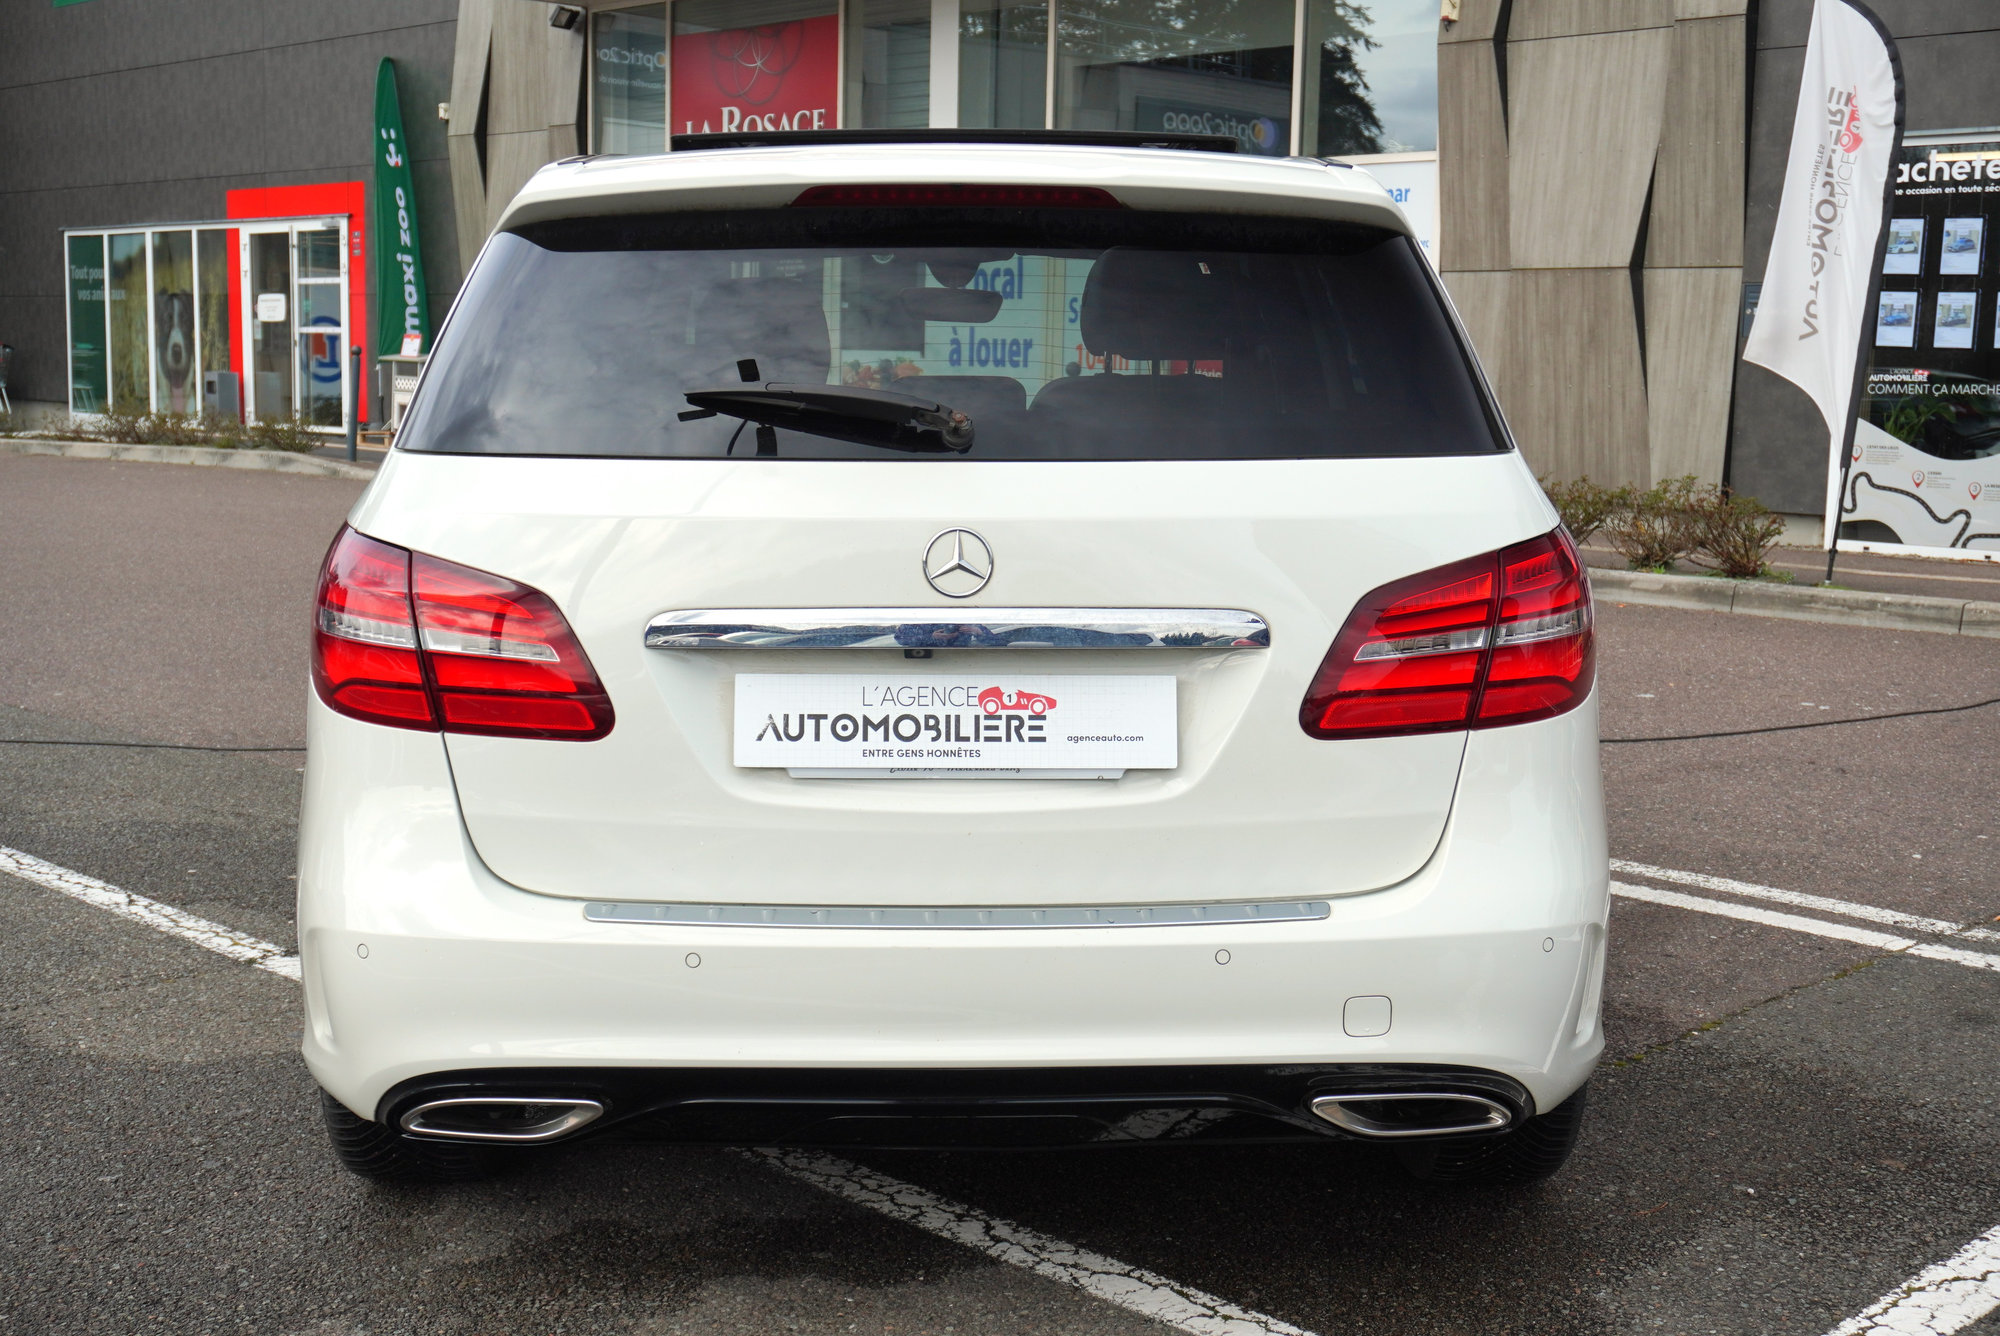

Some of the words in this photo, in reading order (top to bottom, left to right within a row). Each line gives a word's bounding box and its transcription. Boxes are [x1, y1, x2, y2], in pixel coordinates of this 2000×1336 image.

[1906, 185, 1942, 195] occasion
[1958, 184, 1983, 193] toute
[395, 186, 411, 248] zoo
[70, 265, 88, 280] Tout
[88, 267, 105, 284] pou
[91, 286, 126, 301] aniaux
[396, 253, 420, 334] maxi
[948, 326, 962, 367] à
[968, 326, 1033, 368] louer
[1867, 384, 1930, 395] COMMENT
[1932, 384, 1948, 396] ÇA
[1951, 384, 2000, 395] MARCHE
[862, 686, 979, 707] L'AGENCE
[1006, 693, 1013, 703] 1
[1067, 734, 1144, 743] agenceauto.com
[862, 749, 894, 758] ENTRE
[897, 749, 924, 758] GENS
[927, 746, 981, 758] HONNÊTES
